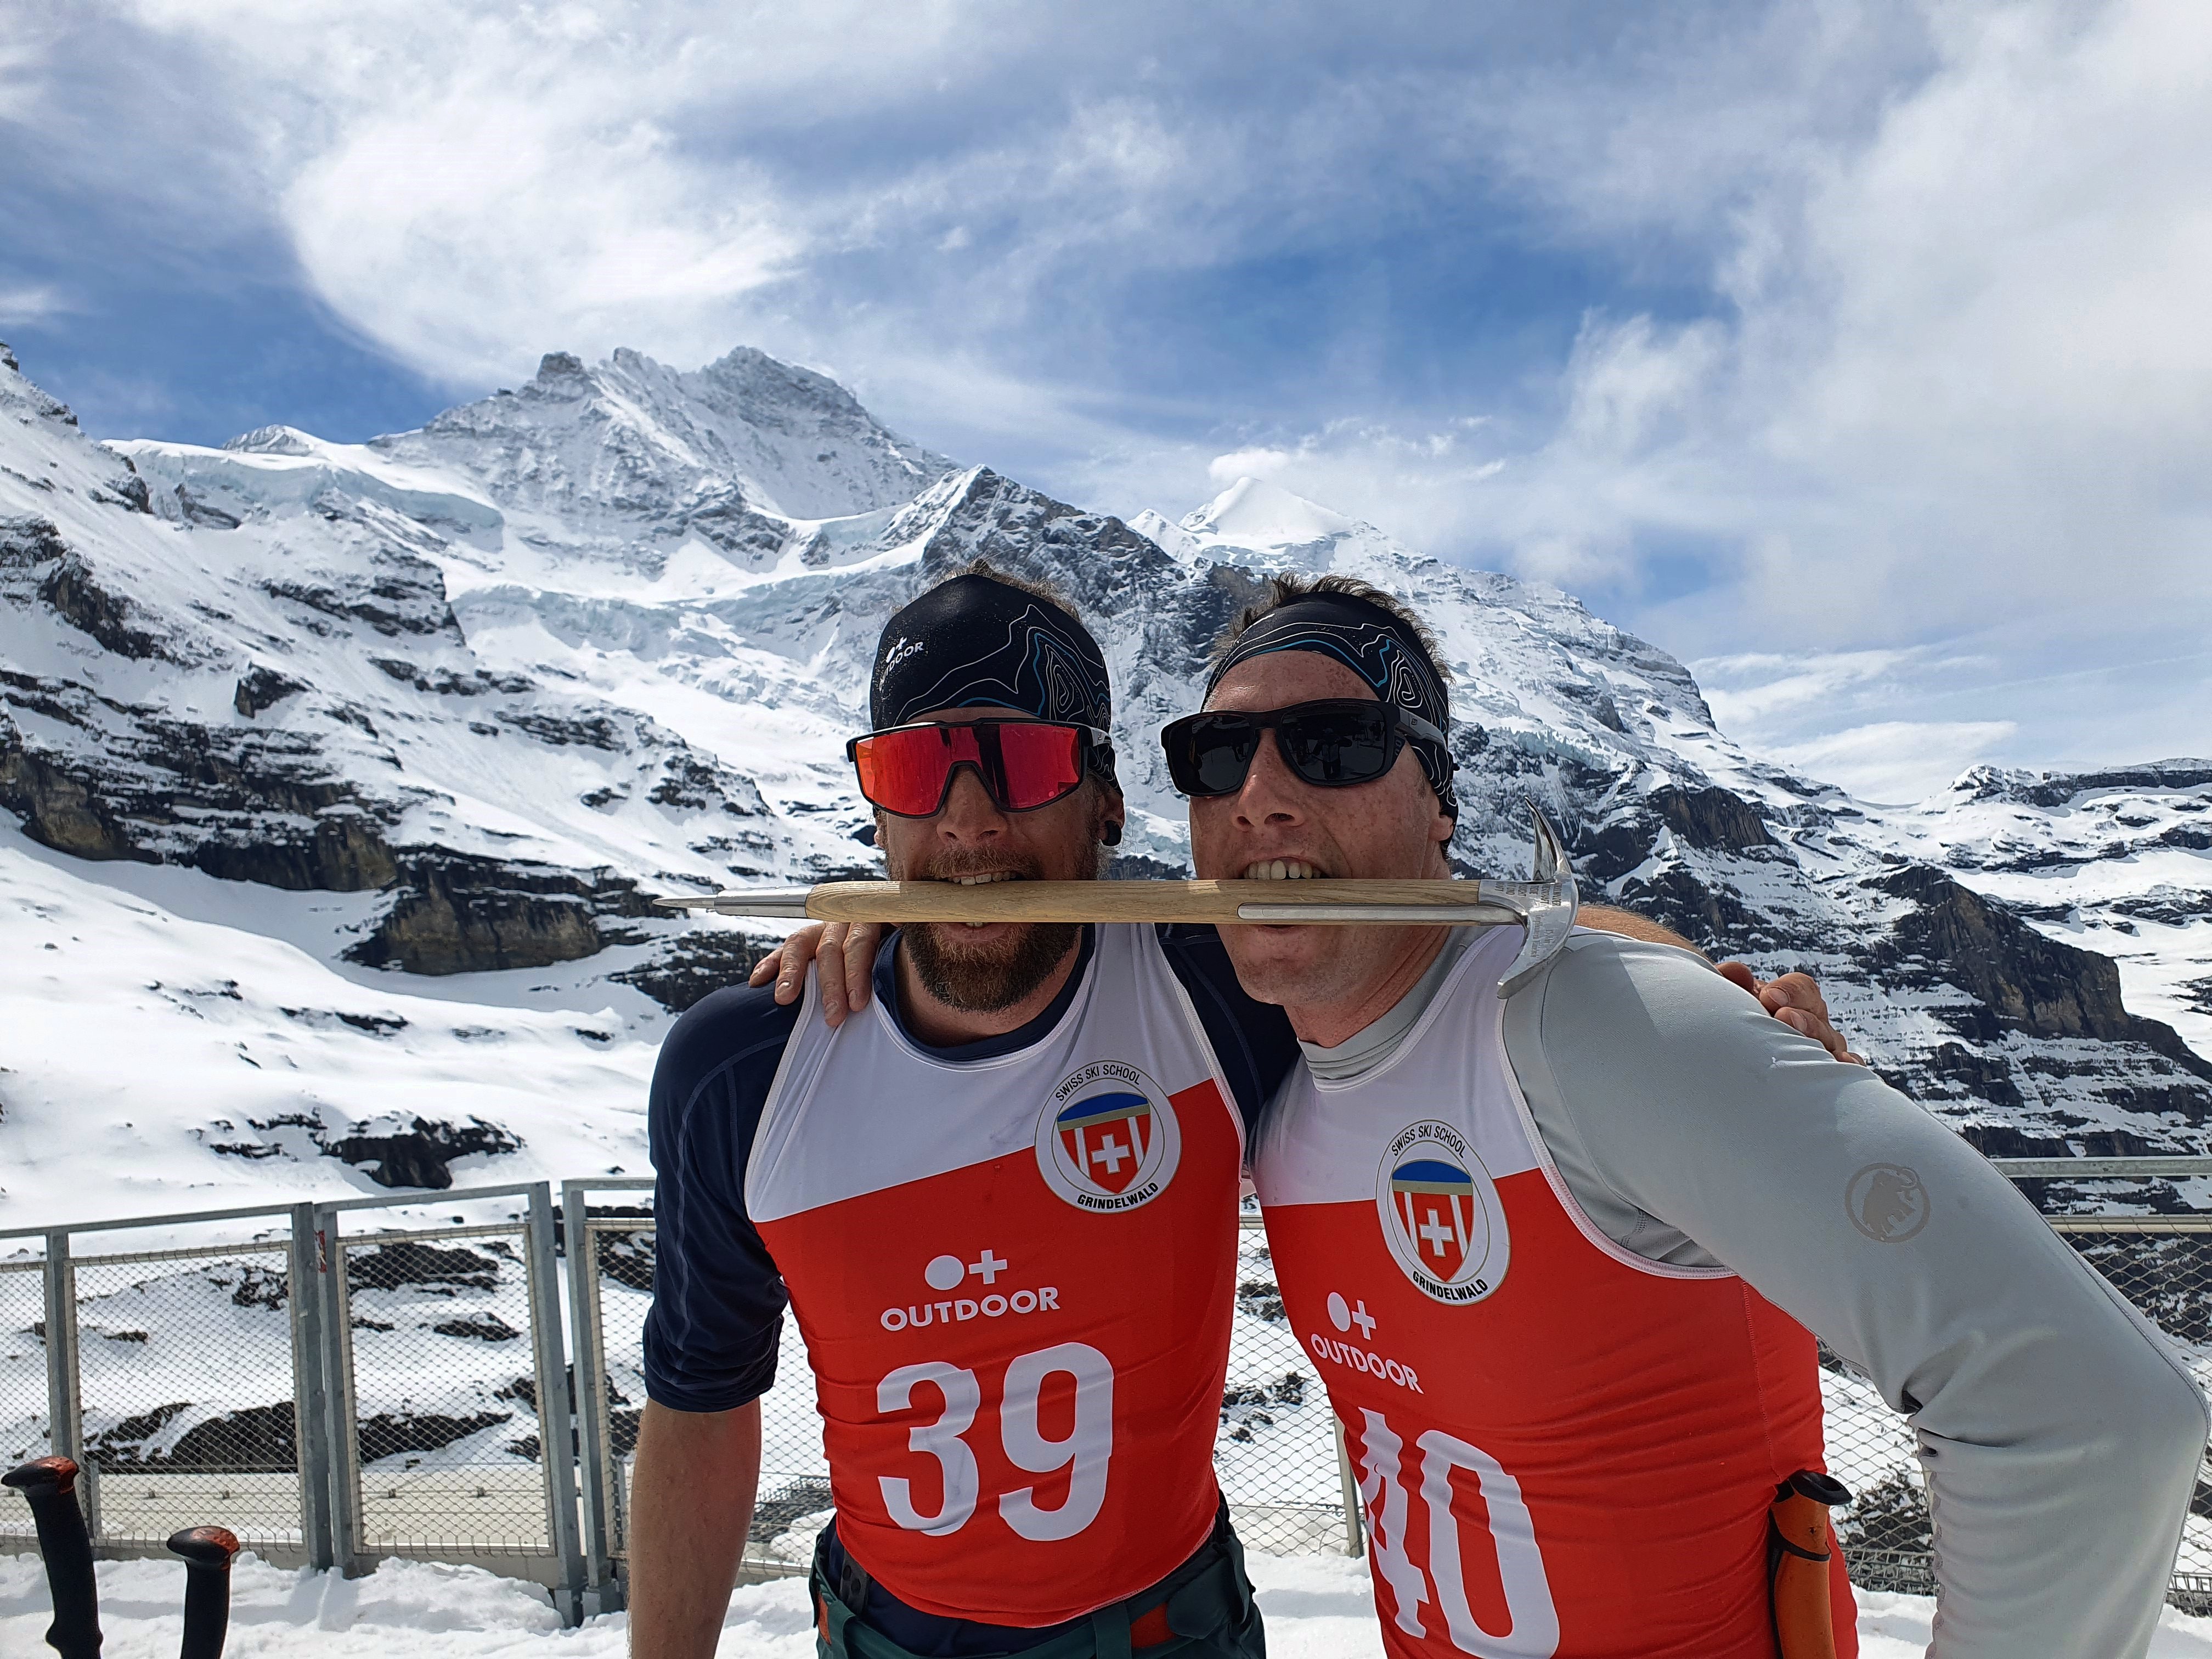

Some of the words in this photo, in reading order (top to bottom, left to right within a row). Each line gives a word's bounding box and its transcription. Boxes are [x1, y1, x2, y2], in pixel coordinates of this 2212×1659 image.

[1055, 1074, 1084, 1102] SWISS
[1085, 1066, 1100, 1080] SKI
[1103, 1064, 1141, 1085] SCHOOL
[1391, 1128, 1415, 1156] SWISS
[1418, 1125, 1432, 1137] SKI
[1434, 1126, 1466, 1159] SCHOOL
[1077, 1182, 1159, 1209] GRINDELWALD
[1413, 1271, 1488, 1300] GRINDELWALD
[881, 1286, 1060, 1331] OUTDOOR
[1311, 1333, 1424, 1395] OUTDOOR
[876, 1342, 1114, 1541] 39
[1358, 1406, 1560, 1659] 40
